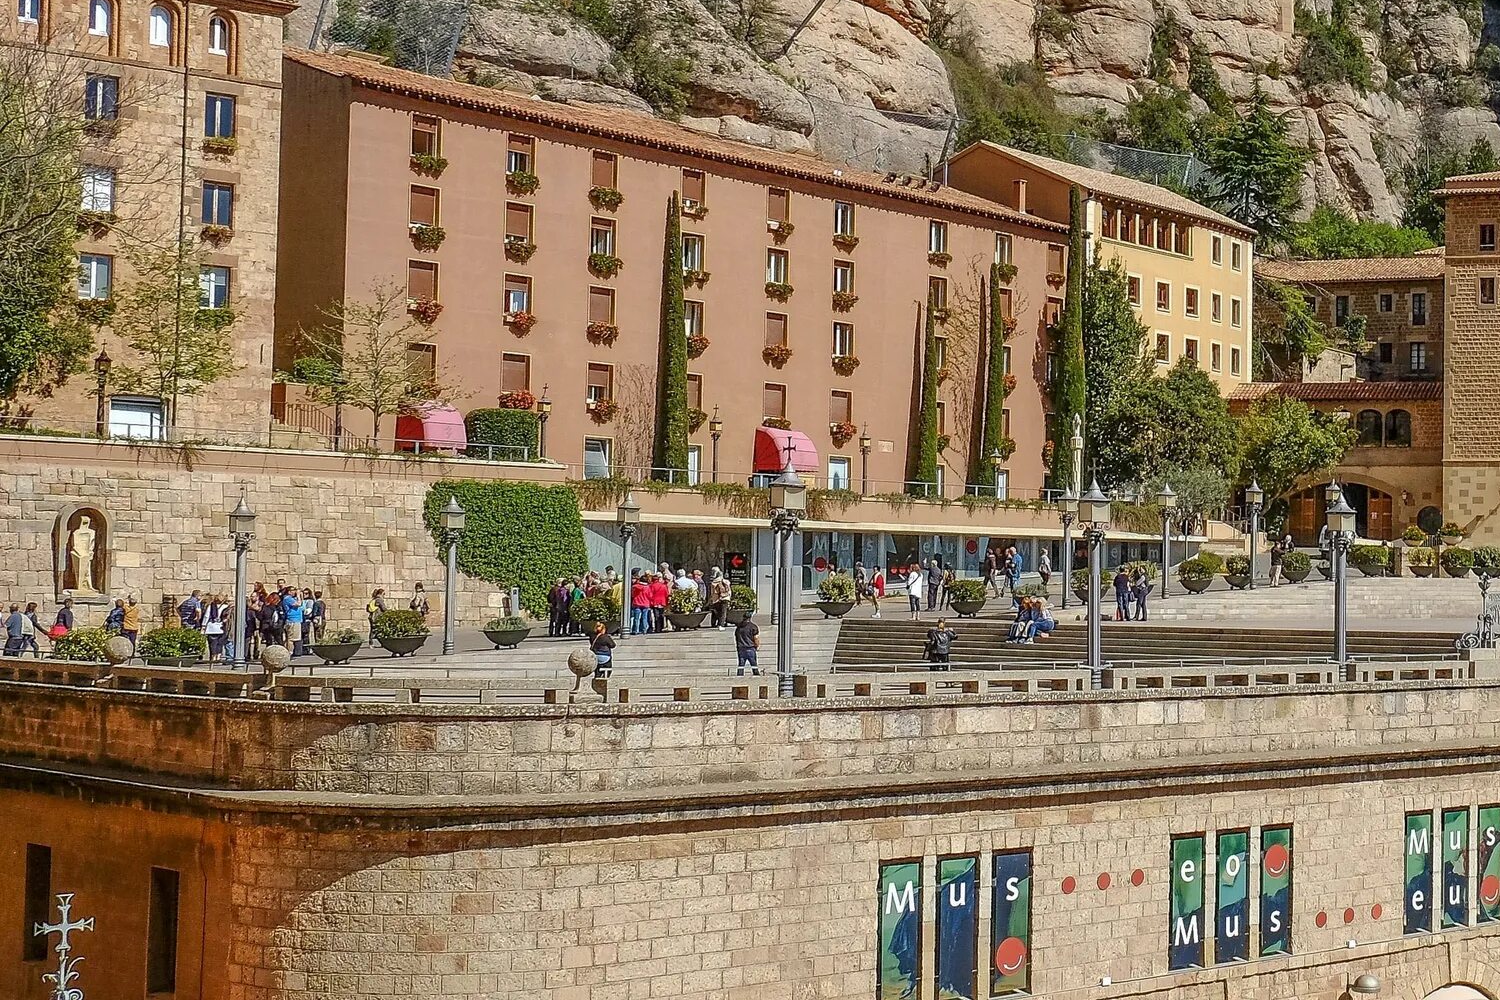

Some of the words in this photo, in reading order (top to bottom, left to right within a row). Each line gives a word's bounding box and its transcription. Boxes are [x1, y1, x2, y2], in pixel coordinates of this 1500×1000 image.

[1408, 826, 1496, 855] Mus
[884, 876, 1019, 915] Mus
[1180, 854, 1240, 882] eo
[1174, 910, 1281, 946] Mus
[1412, 885, 1461, 911] eu
